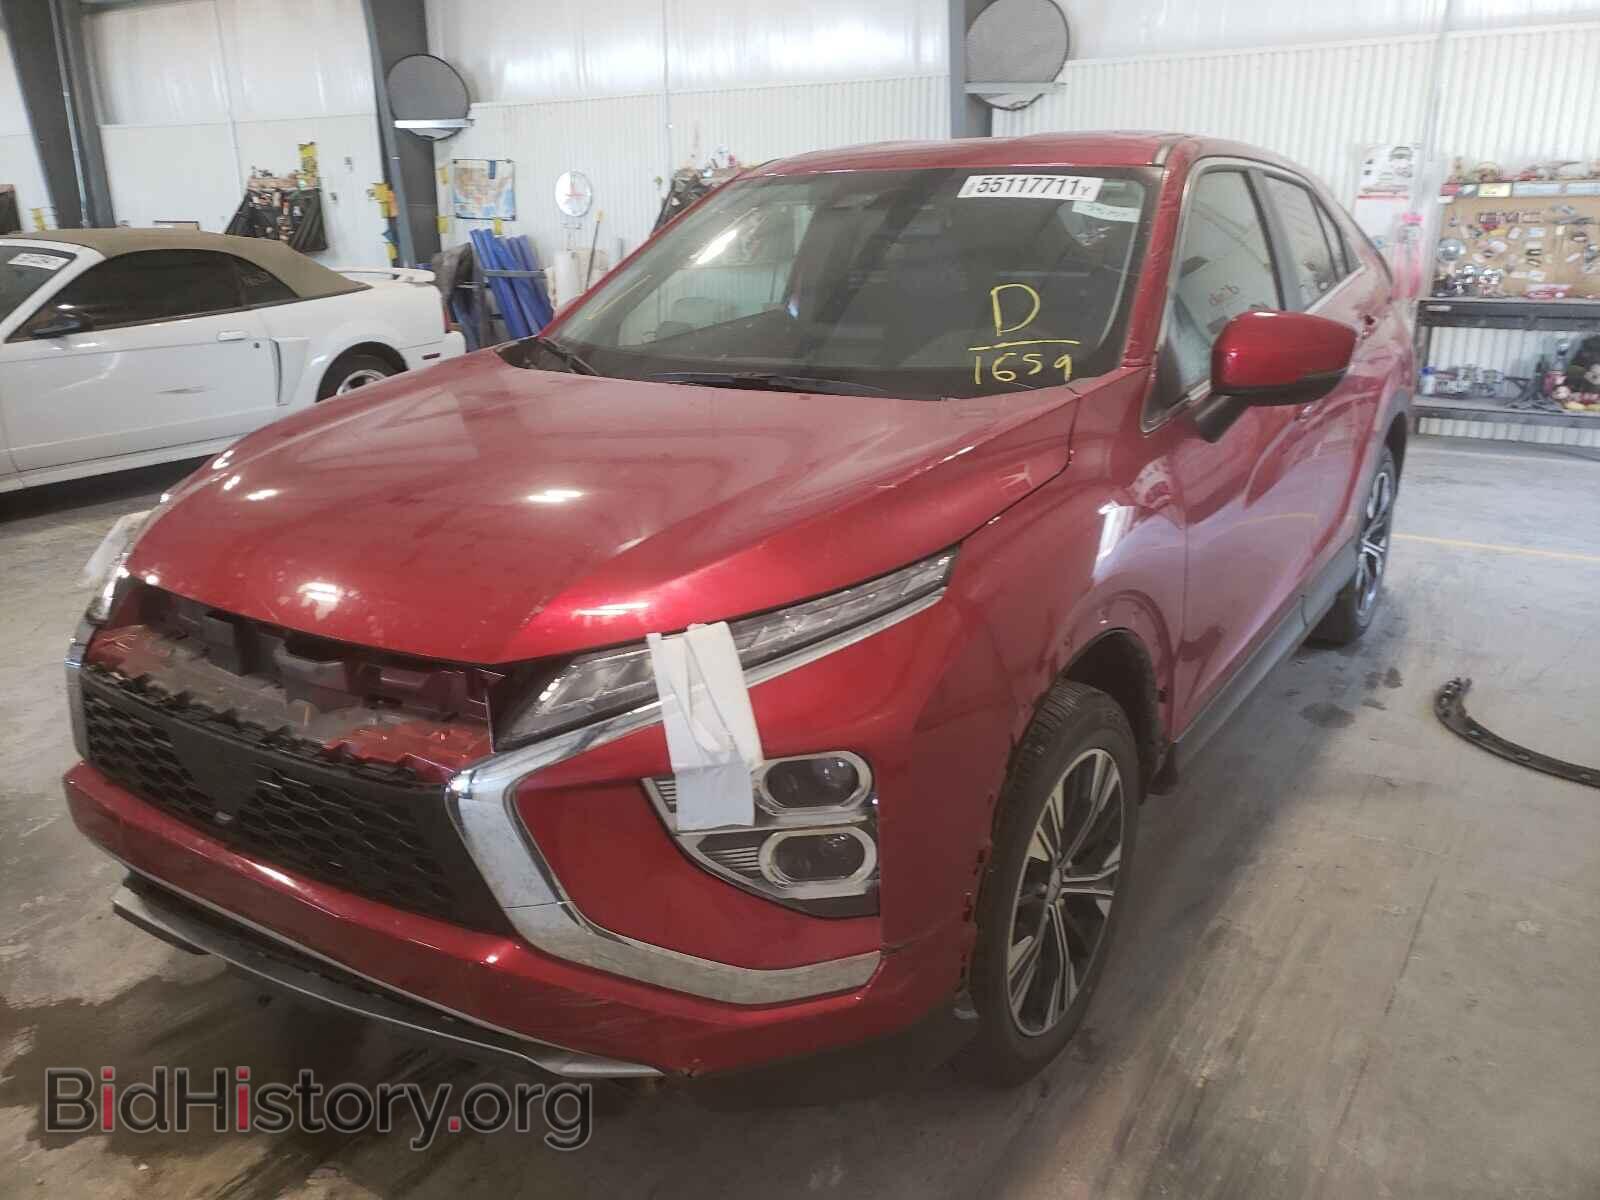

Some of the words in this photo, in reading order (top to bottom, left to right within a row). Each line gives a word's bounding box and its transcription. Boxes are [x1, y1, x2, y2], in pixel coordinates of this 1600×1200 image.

[977, 177, 1081, 196] 55117711
[990, 283, 1041, 337] D
[974, 352, 1073, 385] 1659
